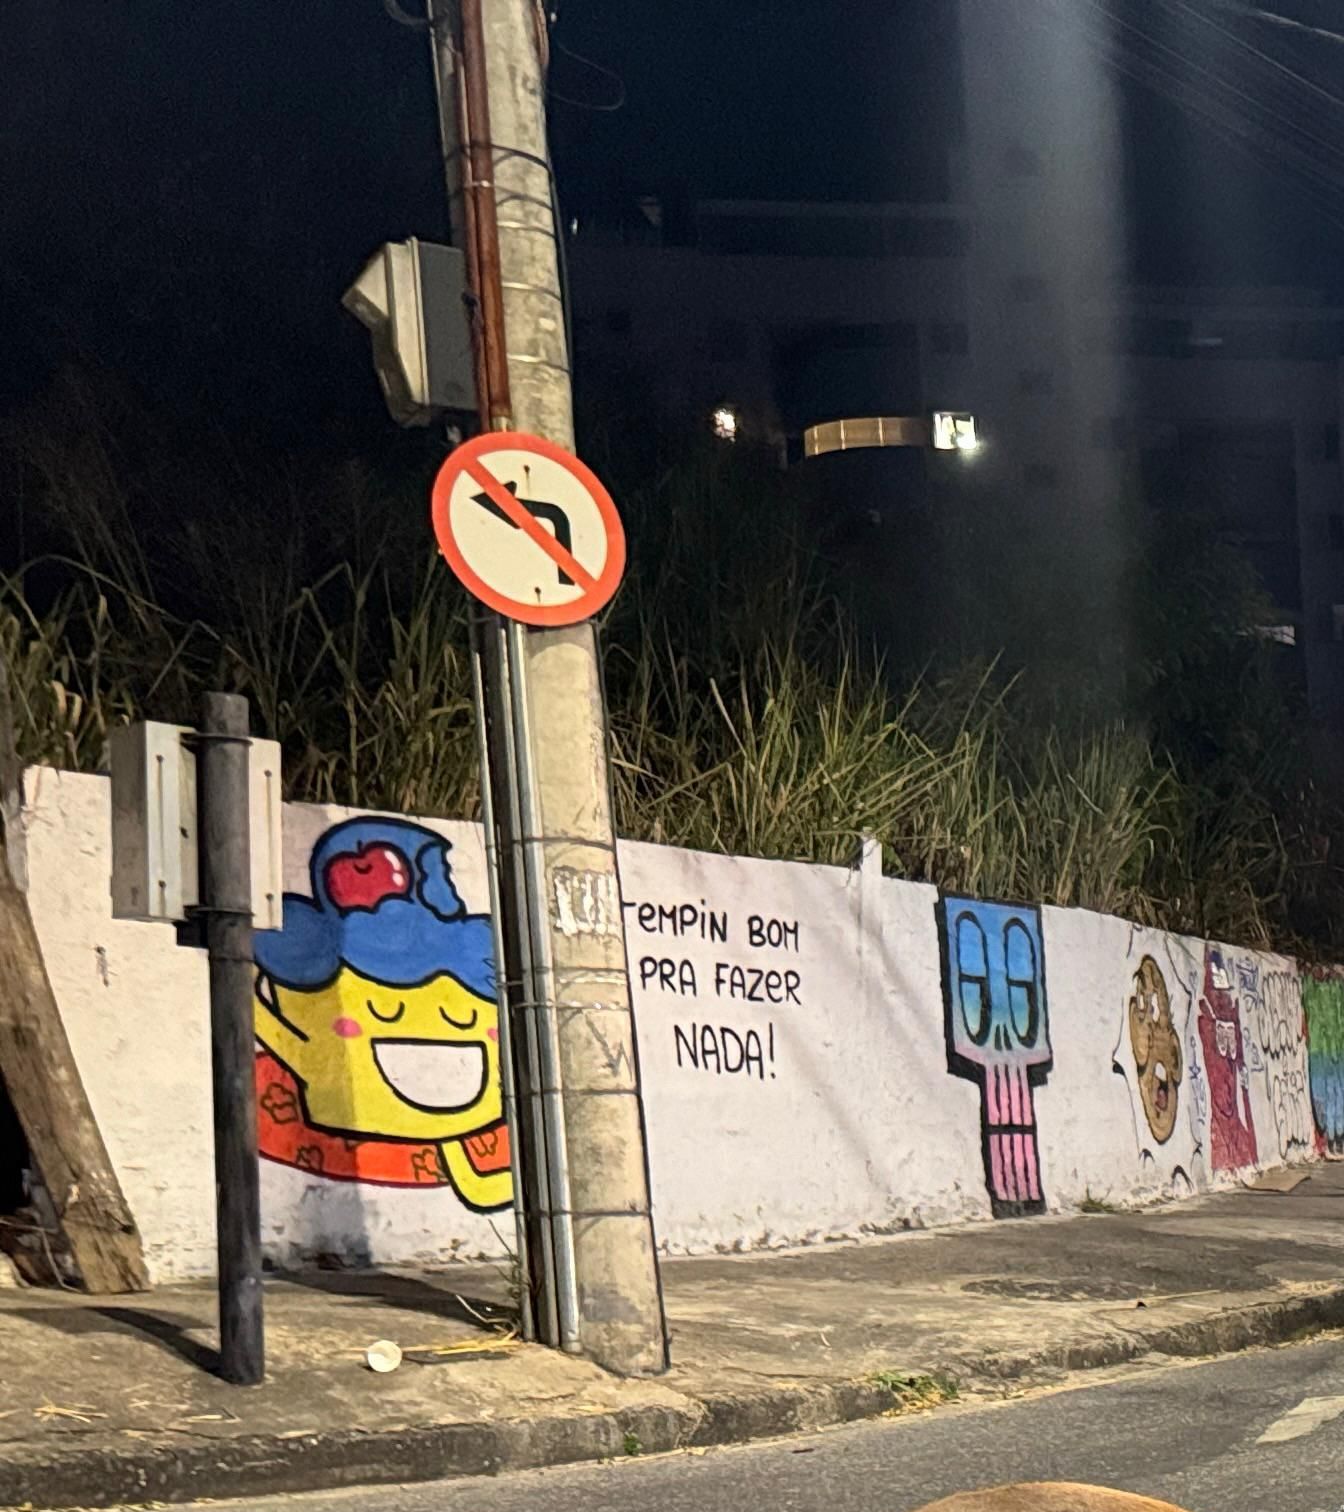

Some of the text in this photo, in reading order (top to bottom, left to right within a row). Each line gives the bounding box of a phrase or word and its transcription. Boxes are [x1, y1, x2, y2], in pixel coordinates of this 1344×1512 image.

[747, 914, 799, 953] BOM
[639, 956, 698, 998] PRA
[673, 1021, 777, 1081] NADA!
